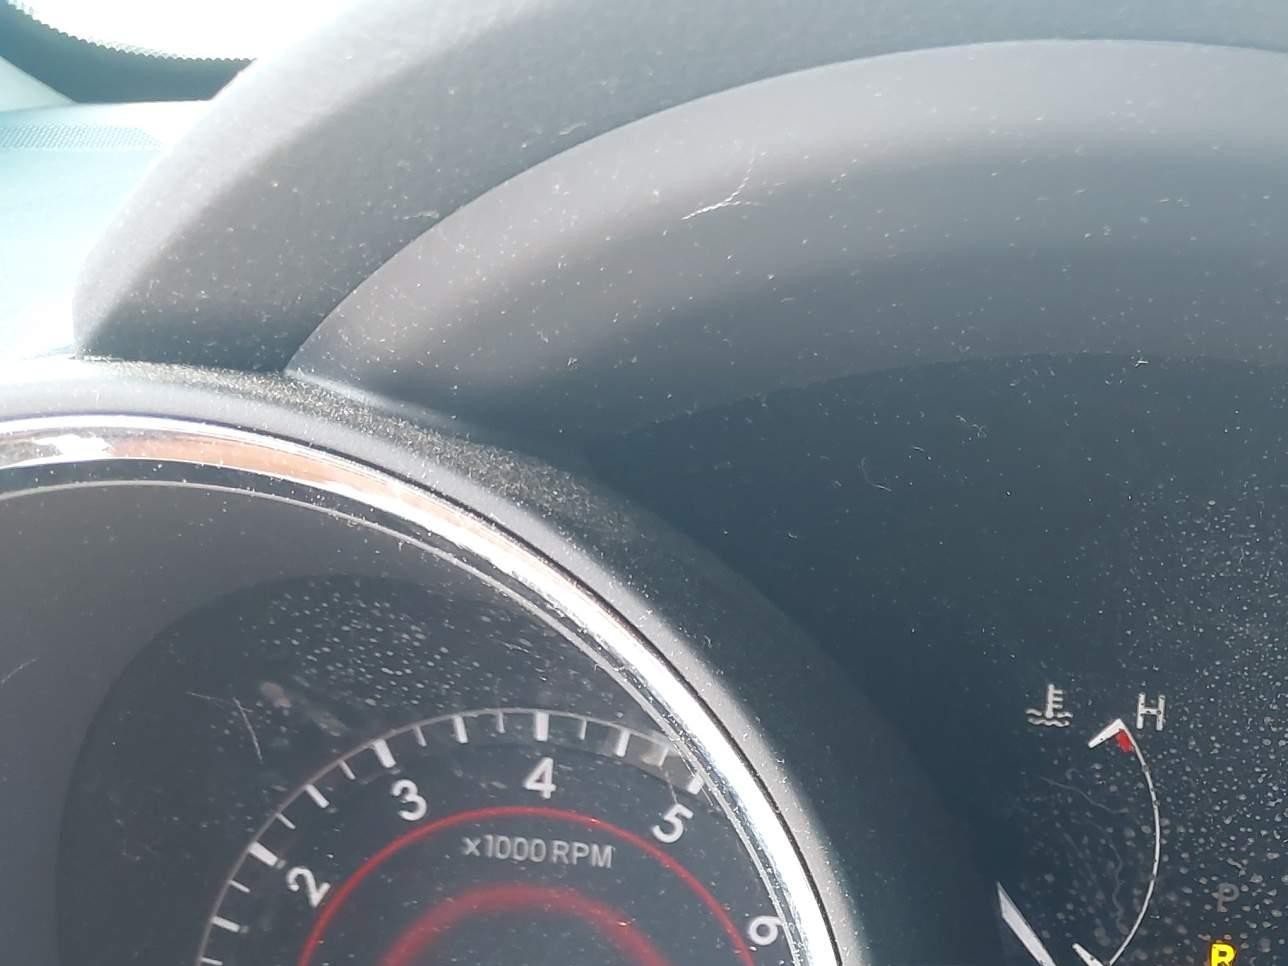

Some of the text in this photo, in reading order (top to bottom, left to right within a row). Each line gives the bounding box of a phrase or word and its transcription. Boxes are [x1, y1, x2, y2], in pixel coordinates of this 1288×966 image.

[1137, 693, 1165, 731] H
[524, 758, 556, 799] 4
[392, 780, 427, 821] 3
[653, 805, 693, 843] 5
[550, 841, 613, 869] RPM
[285, 867, 329, 905] 2
[1216, 882, 1239, 912] P
[748, 915, 783, 945] 6
